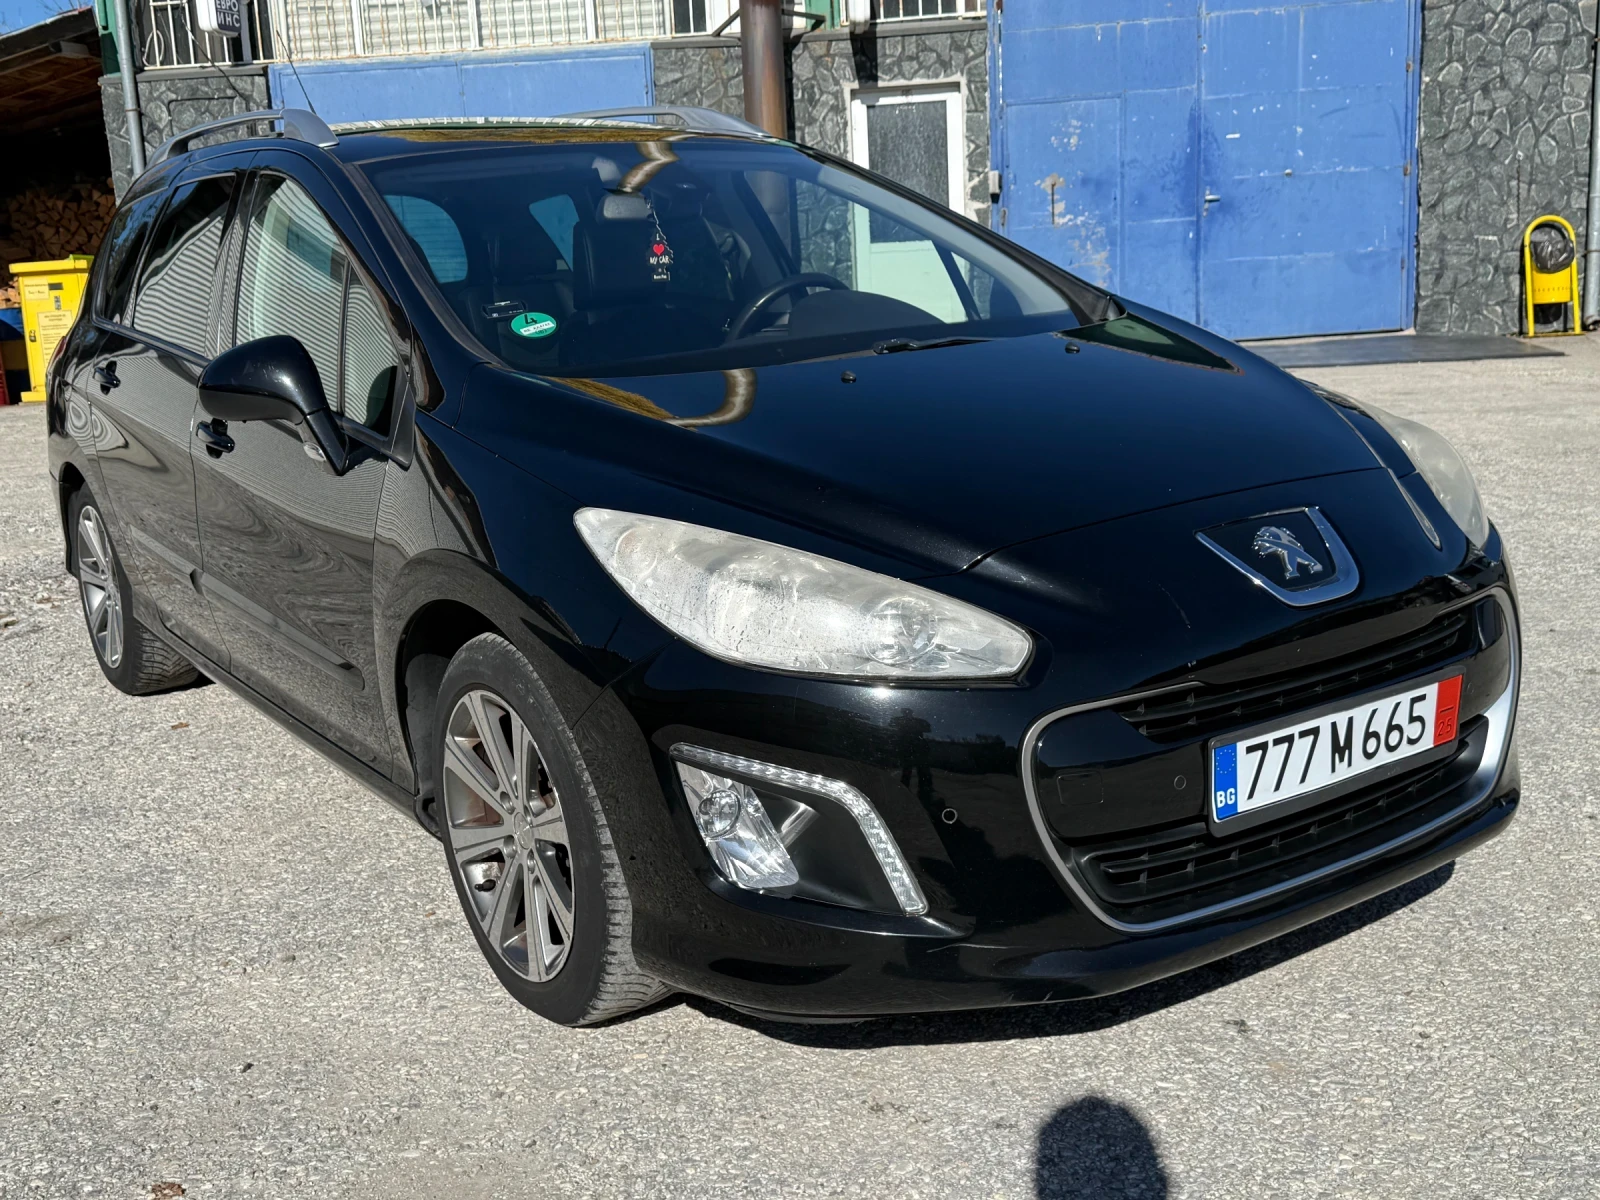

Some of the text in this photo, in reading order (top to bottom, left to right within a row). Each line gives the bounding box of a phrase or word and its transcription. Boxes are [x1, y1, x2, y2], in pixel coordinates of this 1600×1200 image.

[217, 12, 240, 27] ИНС
[659, 254, 670, 264] CAR
[524, 313, 538, 325] 4
[1437, 717, 1452, 737] 25
[1245, 693, 1428, 801] 777 M 665
[1216, 788, 1236, 808] BG
